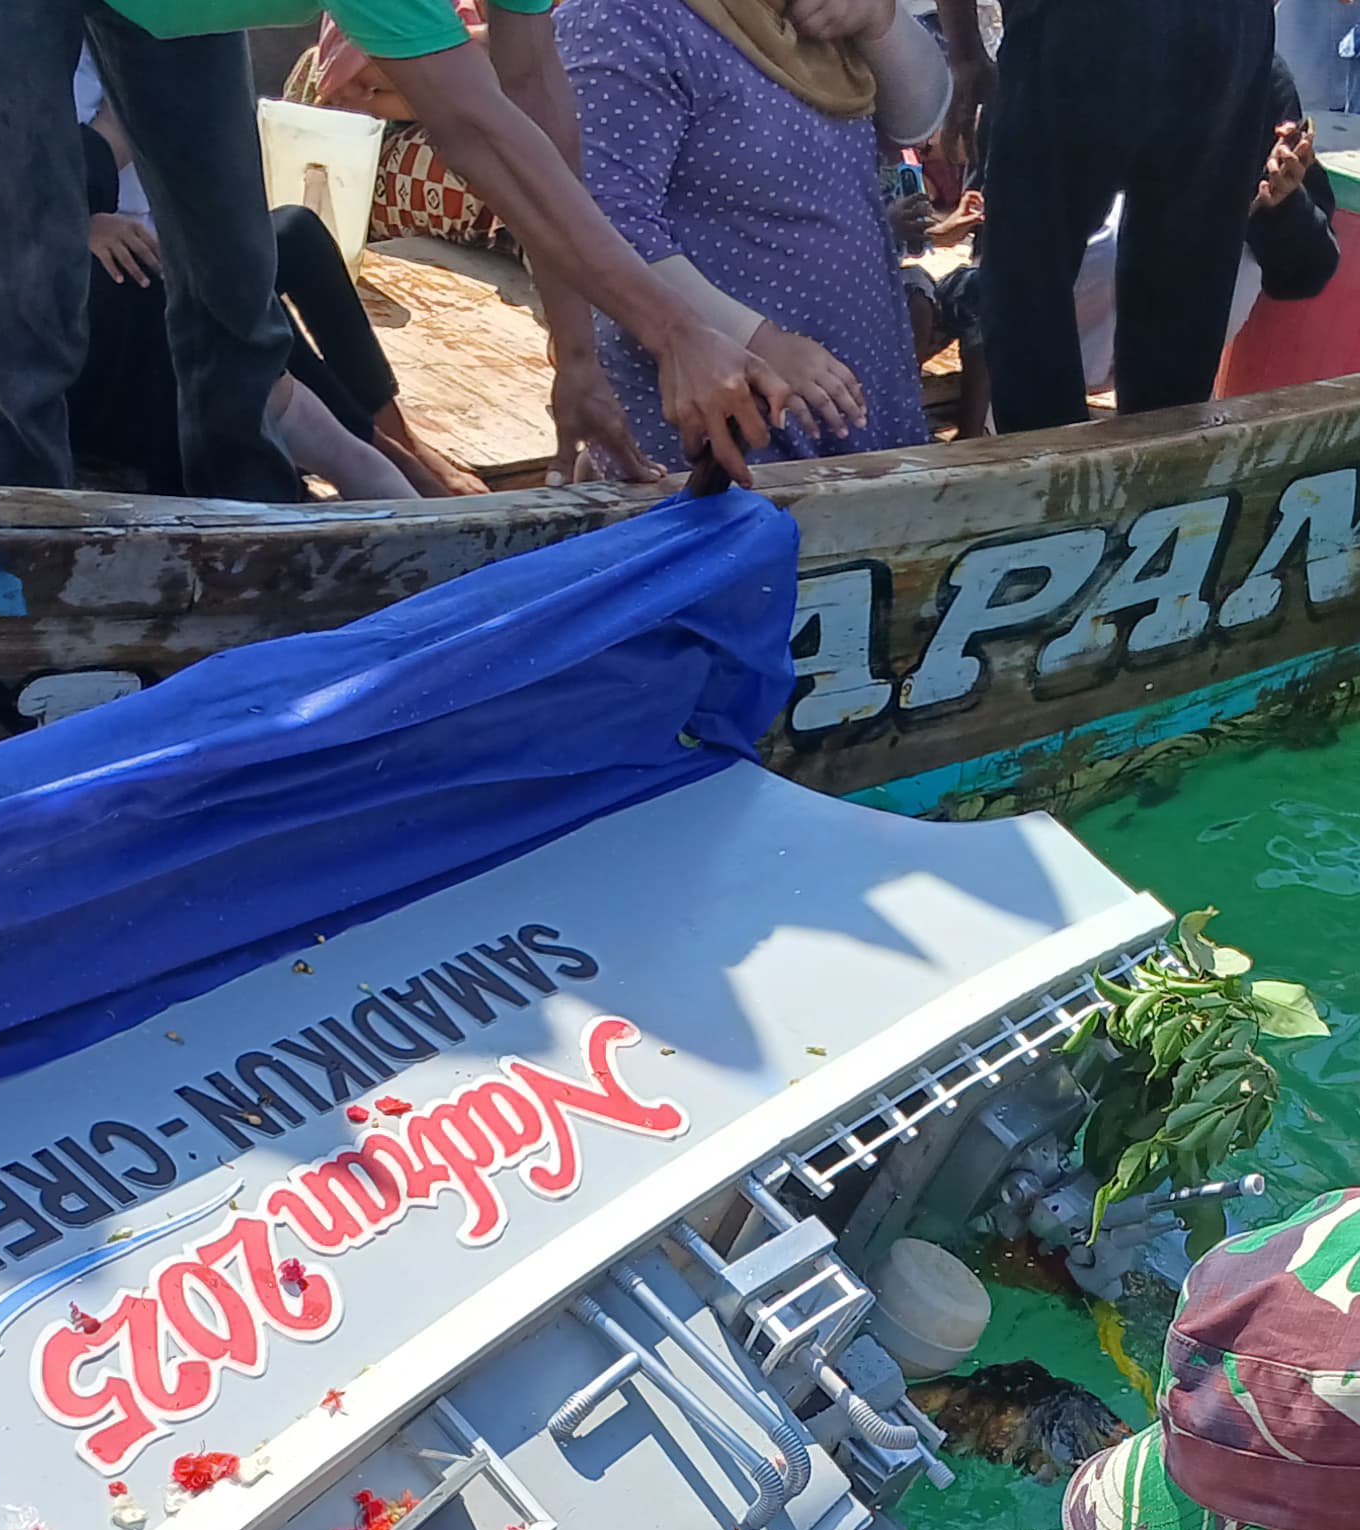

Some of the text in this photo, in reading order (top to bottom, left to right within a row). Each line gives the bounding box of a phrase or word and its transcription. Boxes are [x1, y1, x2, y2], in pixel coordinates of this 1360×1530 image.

[175, 923, 599, 1152] SAMADIKUN
[30, 1013, 691, 1478] Nadran 2025
